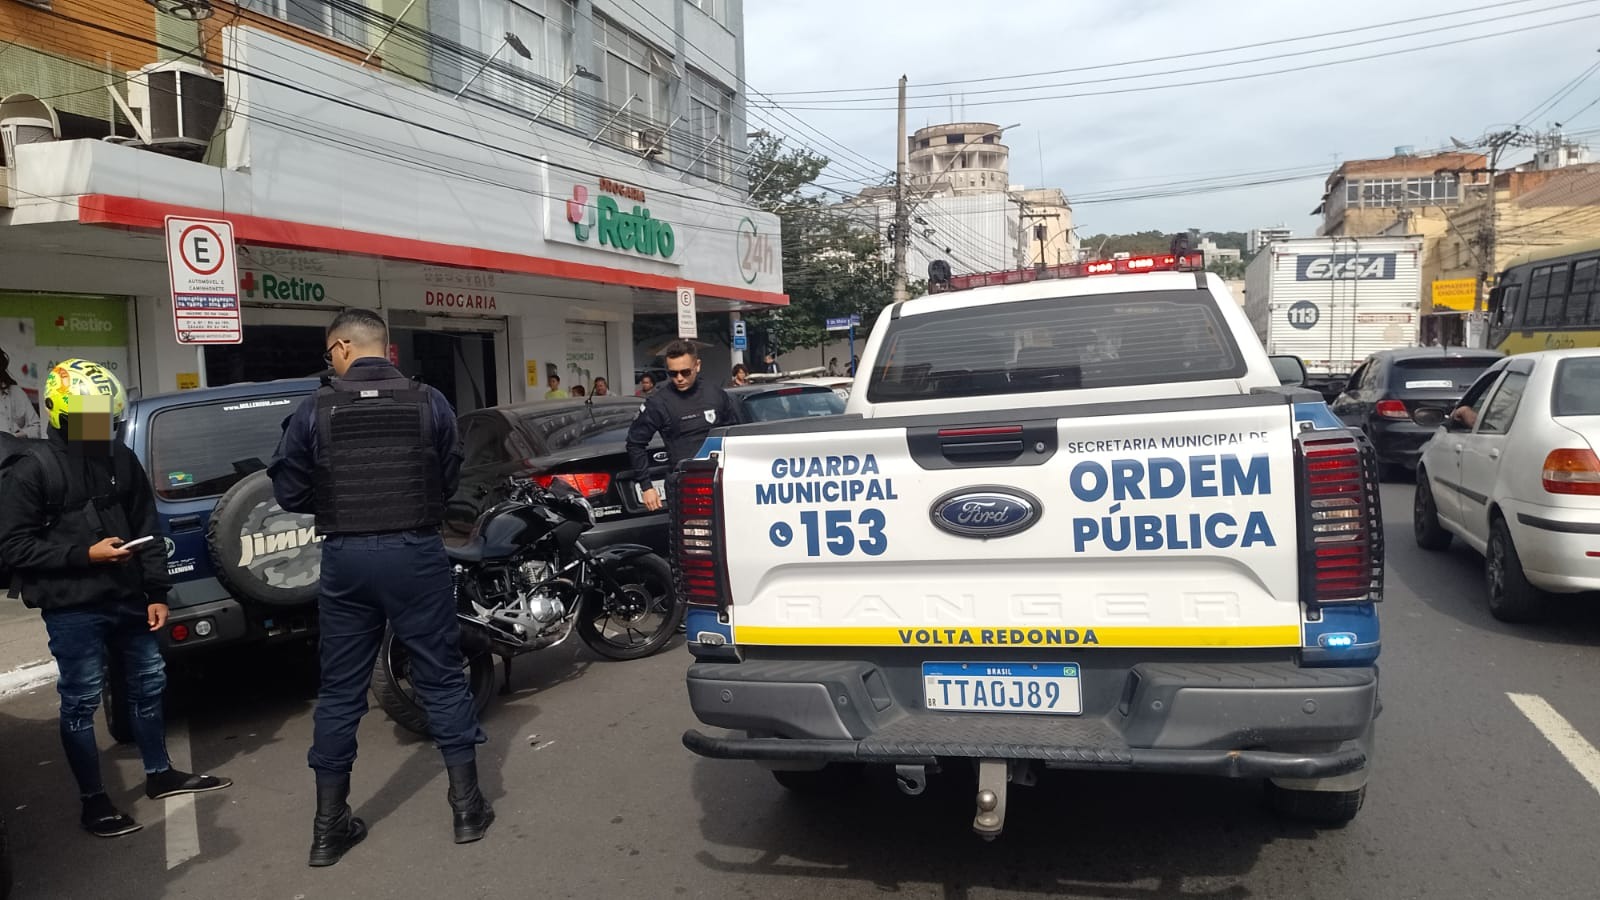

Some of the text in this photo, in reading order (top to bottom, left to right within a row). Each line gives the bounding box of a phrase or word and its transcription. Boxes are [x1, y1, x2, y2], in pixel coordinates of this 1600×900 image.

[599, 178, 646, 203] DROGARIA
[597, 195, 675, 258] Retiro
[194, 237, 210, 263] E
[742, 231, 773, 275] 24h
[262, 274, 325, 302] Retiro
[426, 291, 497, 310] DROGARIA
[70, 318, 112, 332] Retiro
[1289, 307, 1317, 323] 113
[1068, 431, 1268, 454] SECRETARIA MUNICIPAL DE
[771, 454, 880, 479] GUARDA
[1069, 453, 1271, 502] ORDEM
[755, 478, 898, 505] MUNICIPAL
[958, 501, 1009, 524] Ford
[800, 508, 888, 557] 153
[1073, 502, 1276, 552] PÚBLICA
[776, 592, 1241, 623] RANGER
[898, 629, 1099, 645] VOLTA REDONDA
[986, 668, 1013, 676] BRASIL
